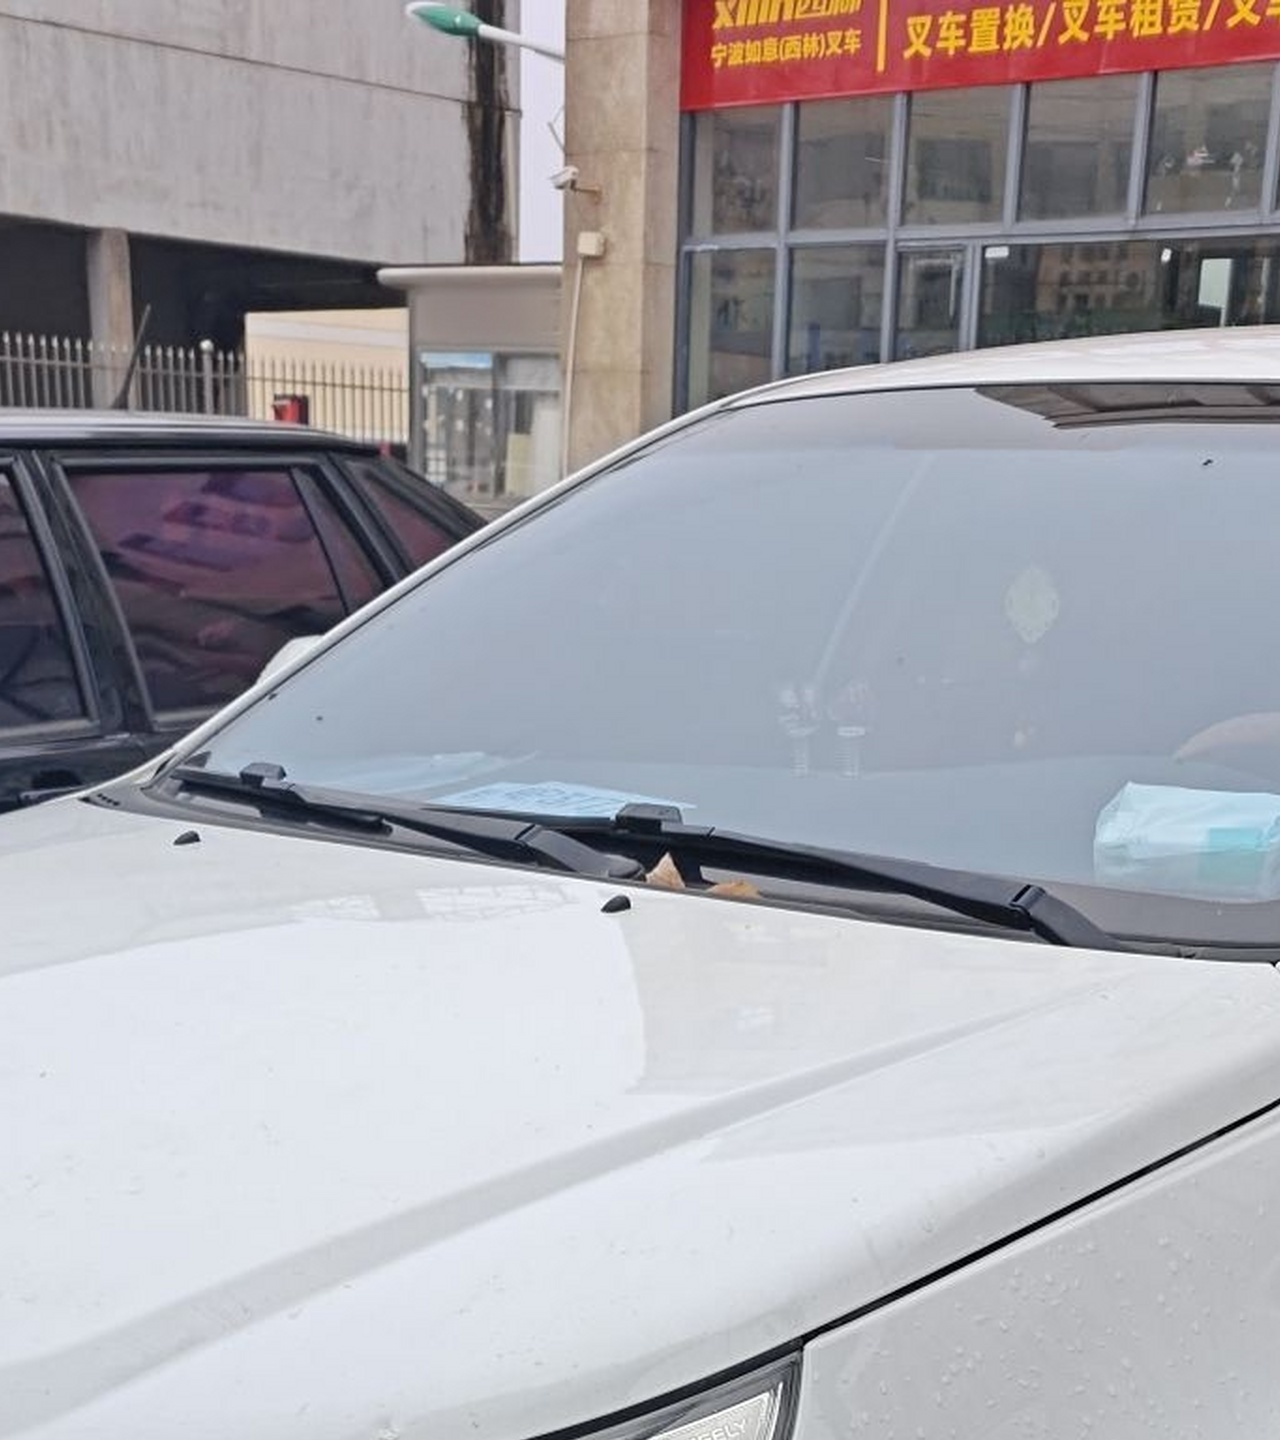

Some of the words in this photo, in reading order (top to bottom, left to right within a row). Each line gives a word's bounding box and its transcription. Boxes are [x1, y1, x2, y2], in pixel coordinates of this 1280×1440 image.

[710, 27, 862, 68] 宁波如意(西林)叉车
